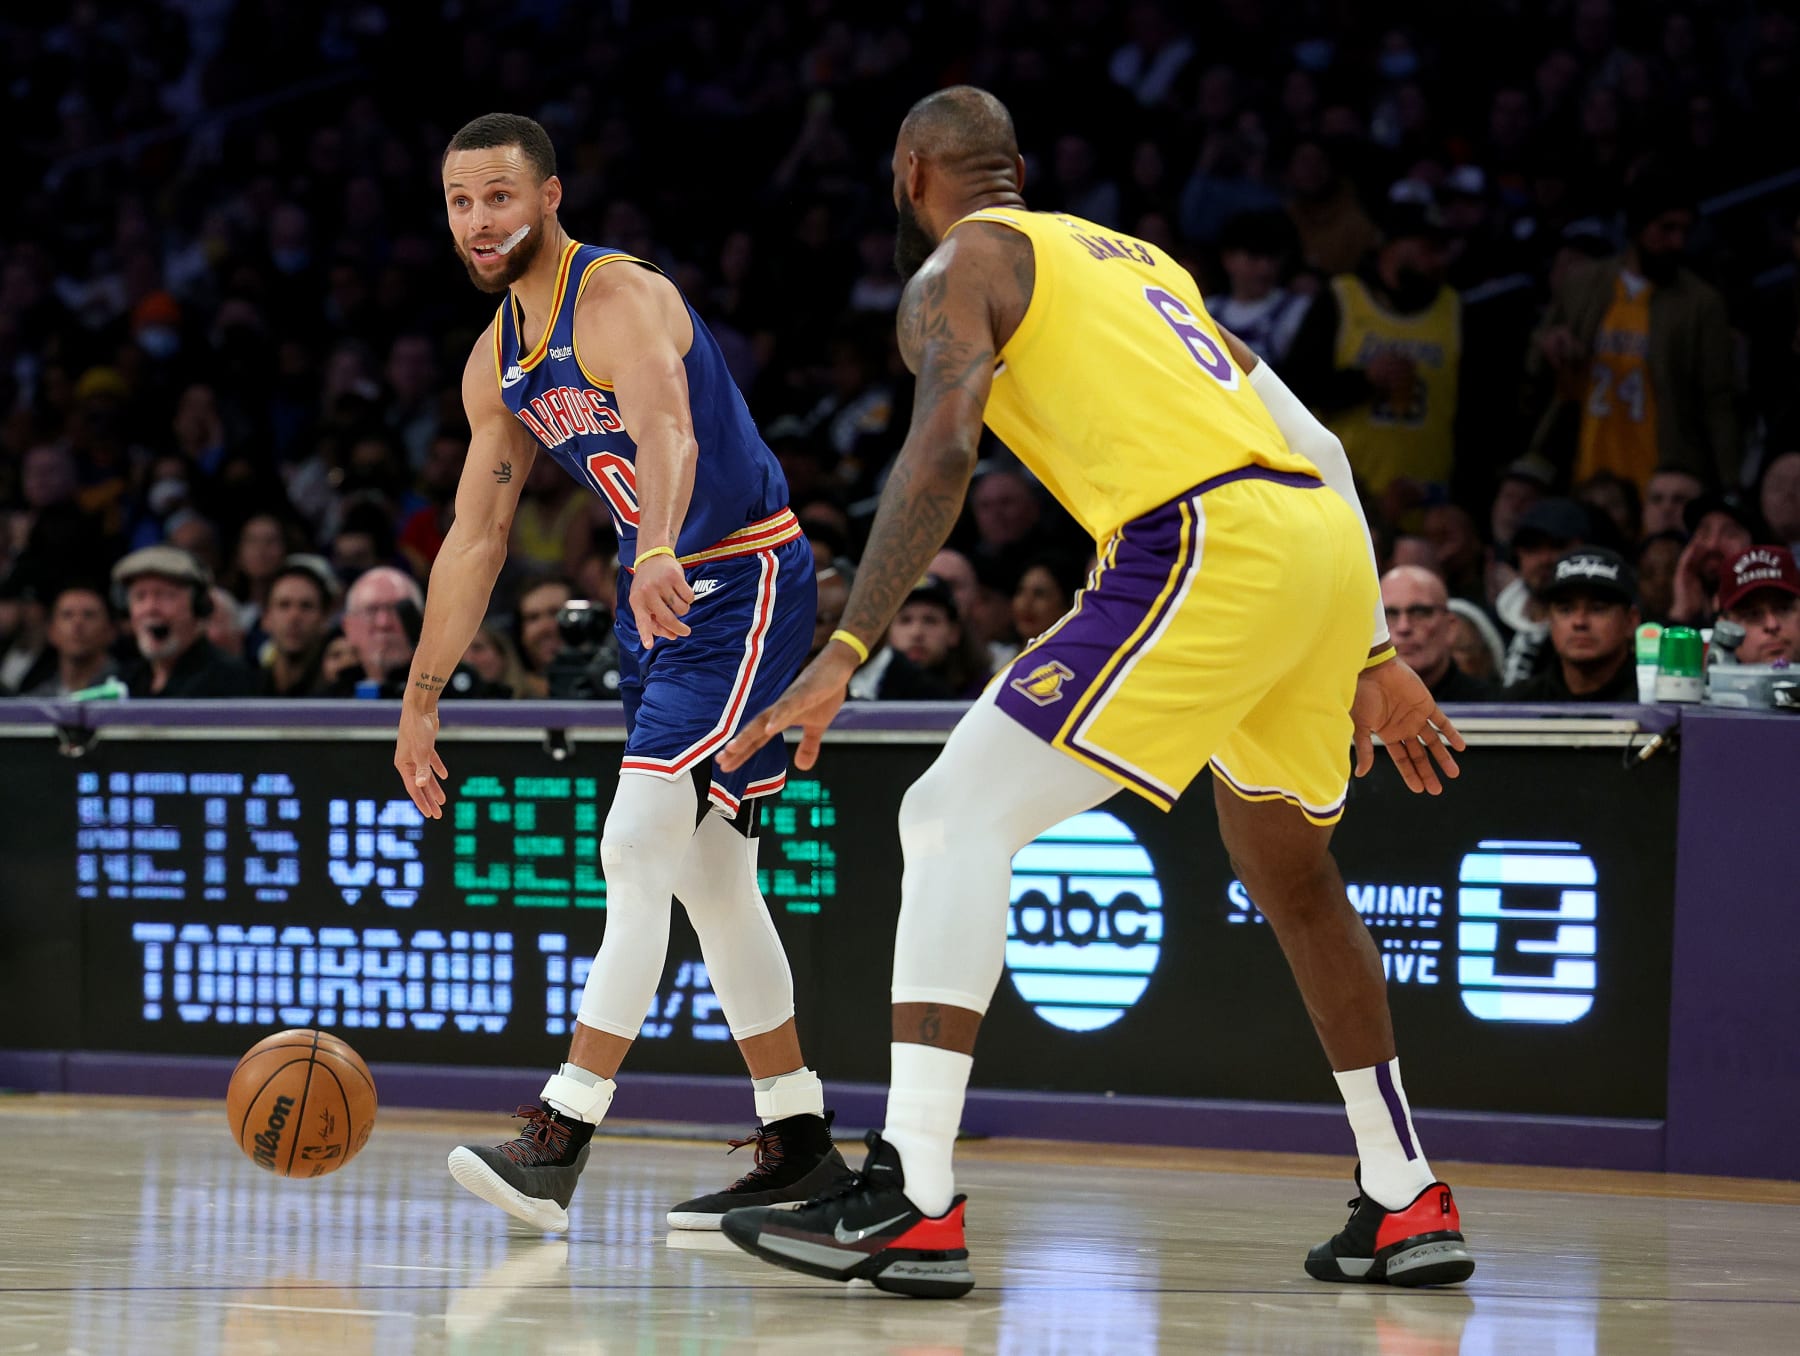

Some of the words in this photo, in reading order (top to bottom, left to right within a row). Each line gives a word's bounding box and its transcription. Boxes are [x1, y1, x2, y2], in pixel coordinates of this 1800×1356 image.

[1143, 284, 1240, 391] 6
[580, 451, 639, 532] 0
[692, 579, 719, 593] NIKE
[77, 772, 300, 902] NETS
[1013, 874, 1147, 949] abc
[132, 922, 514, 1034] TOMORROW
